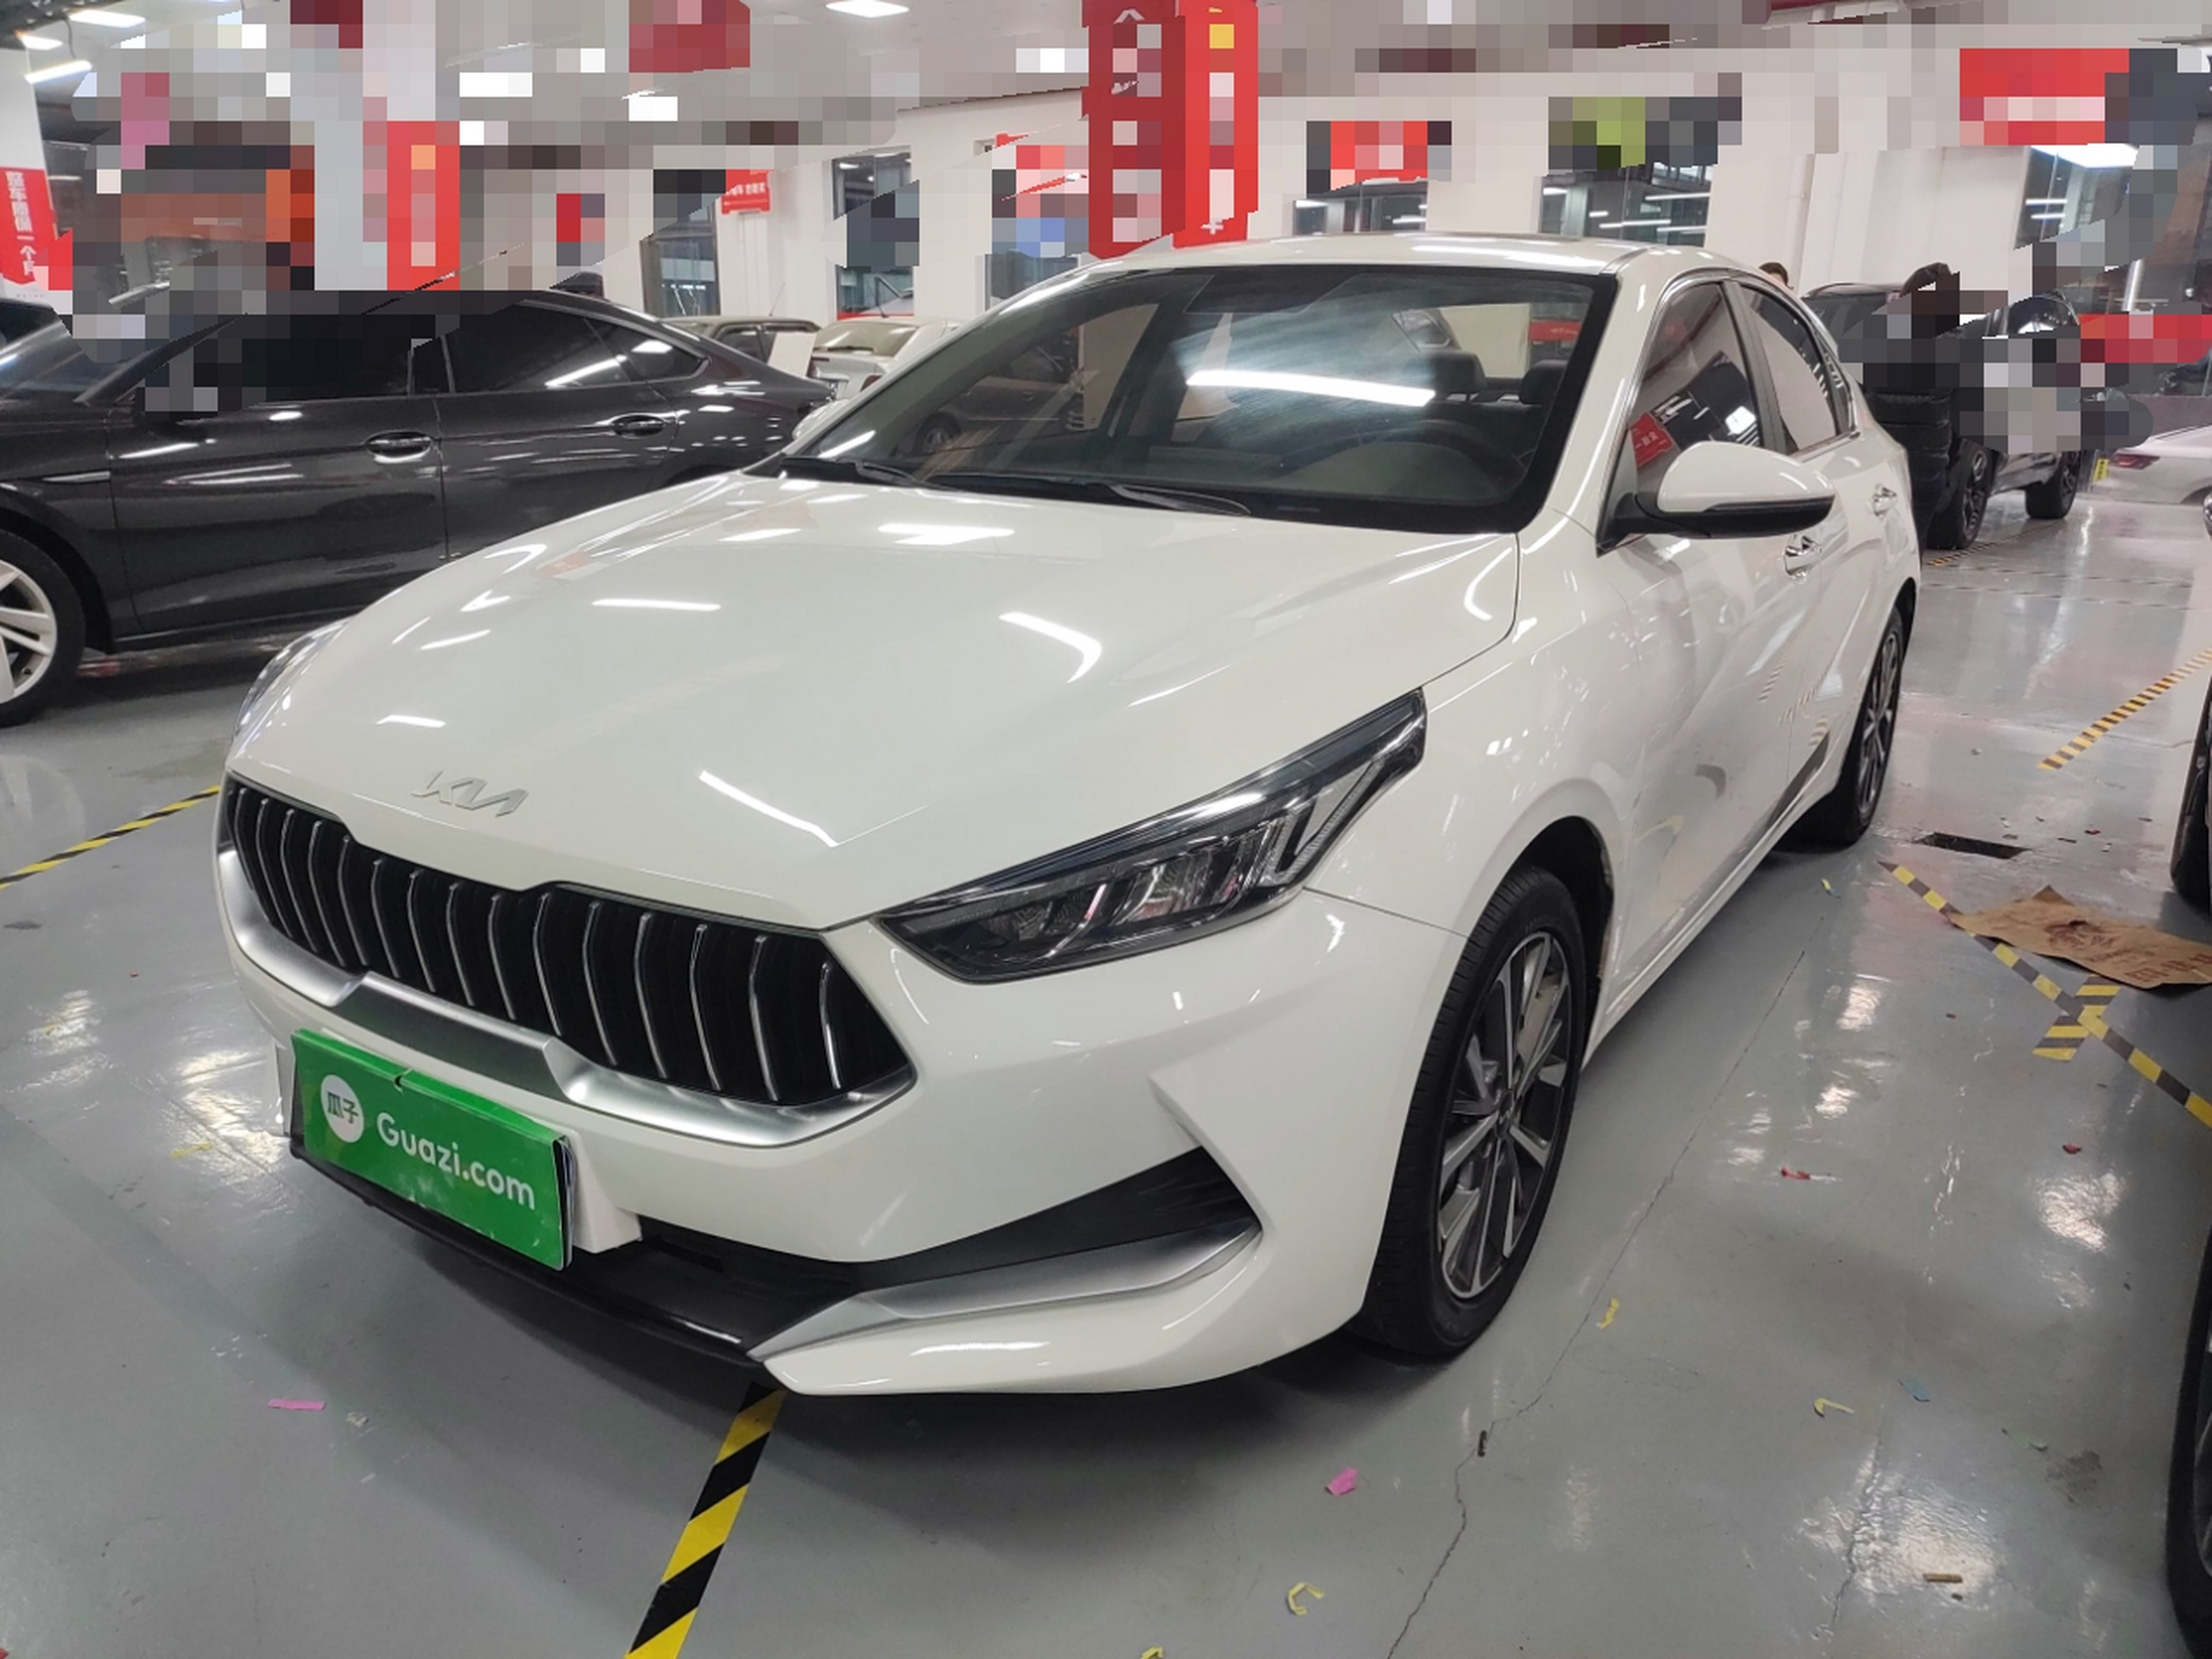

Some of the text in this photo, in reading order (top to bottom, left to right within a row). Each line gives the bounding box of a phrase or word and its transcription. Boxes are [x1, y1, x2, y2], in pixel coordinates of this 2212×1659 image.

[411, 770, 529, 818] KIA
[327, 1092, 359, 1124] 瓜子
[376, 1112, 535, 1210] Guazi.com
